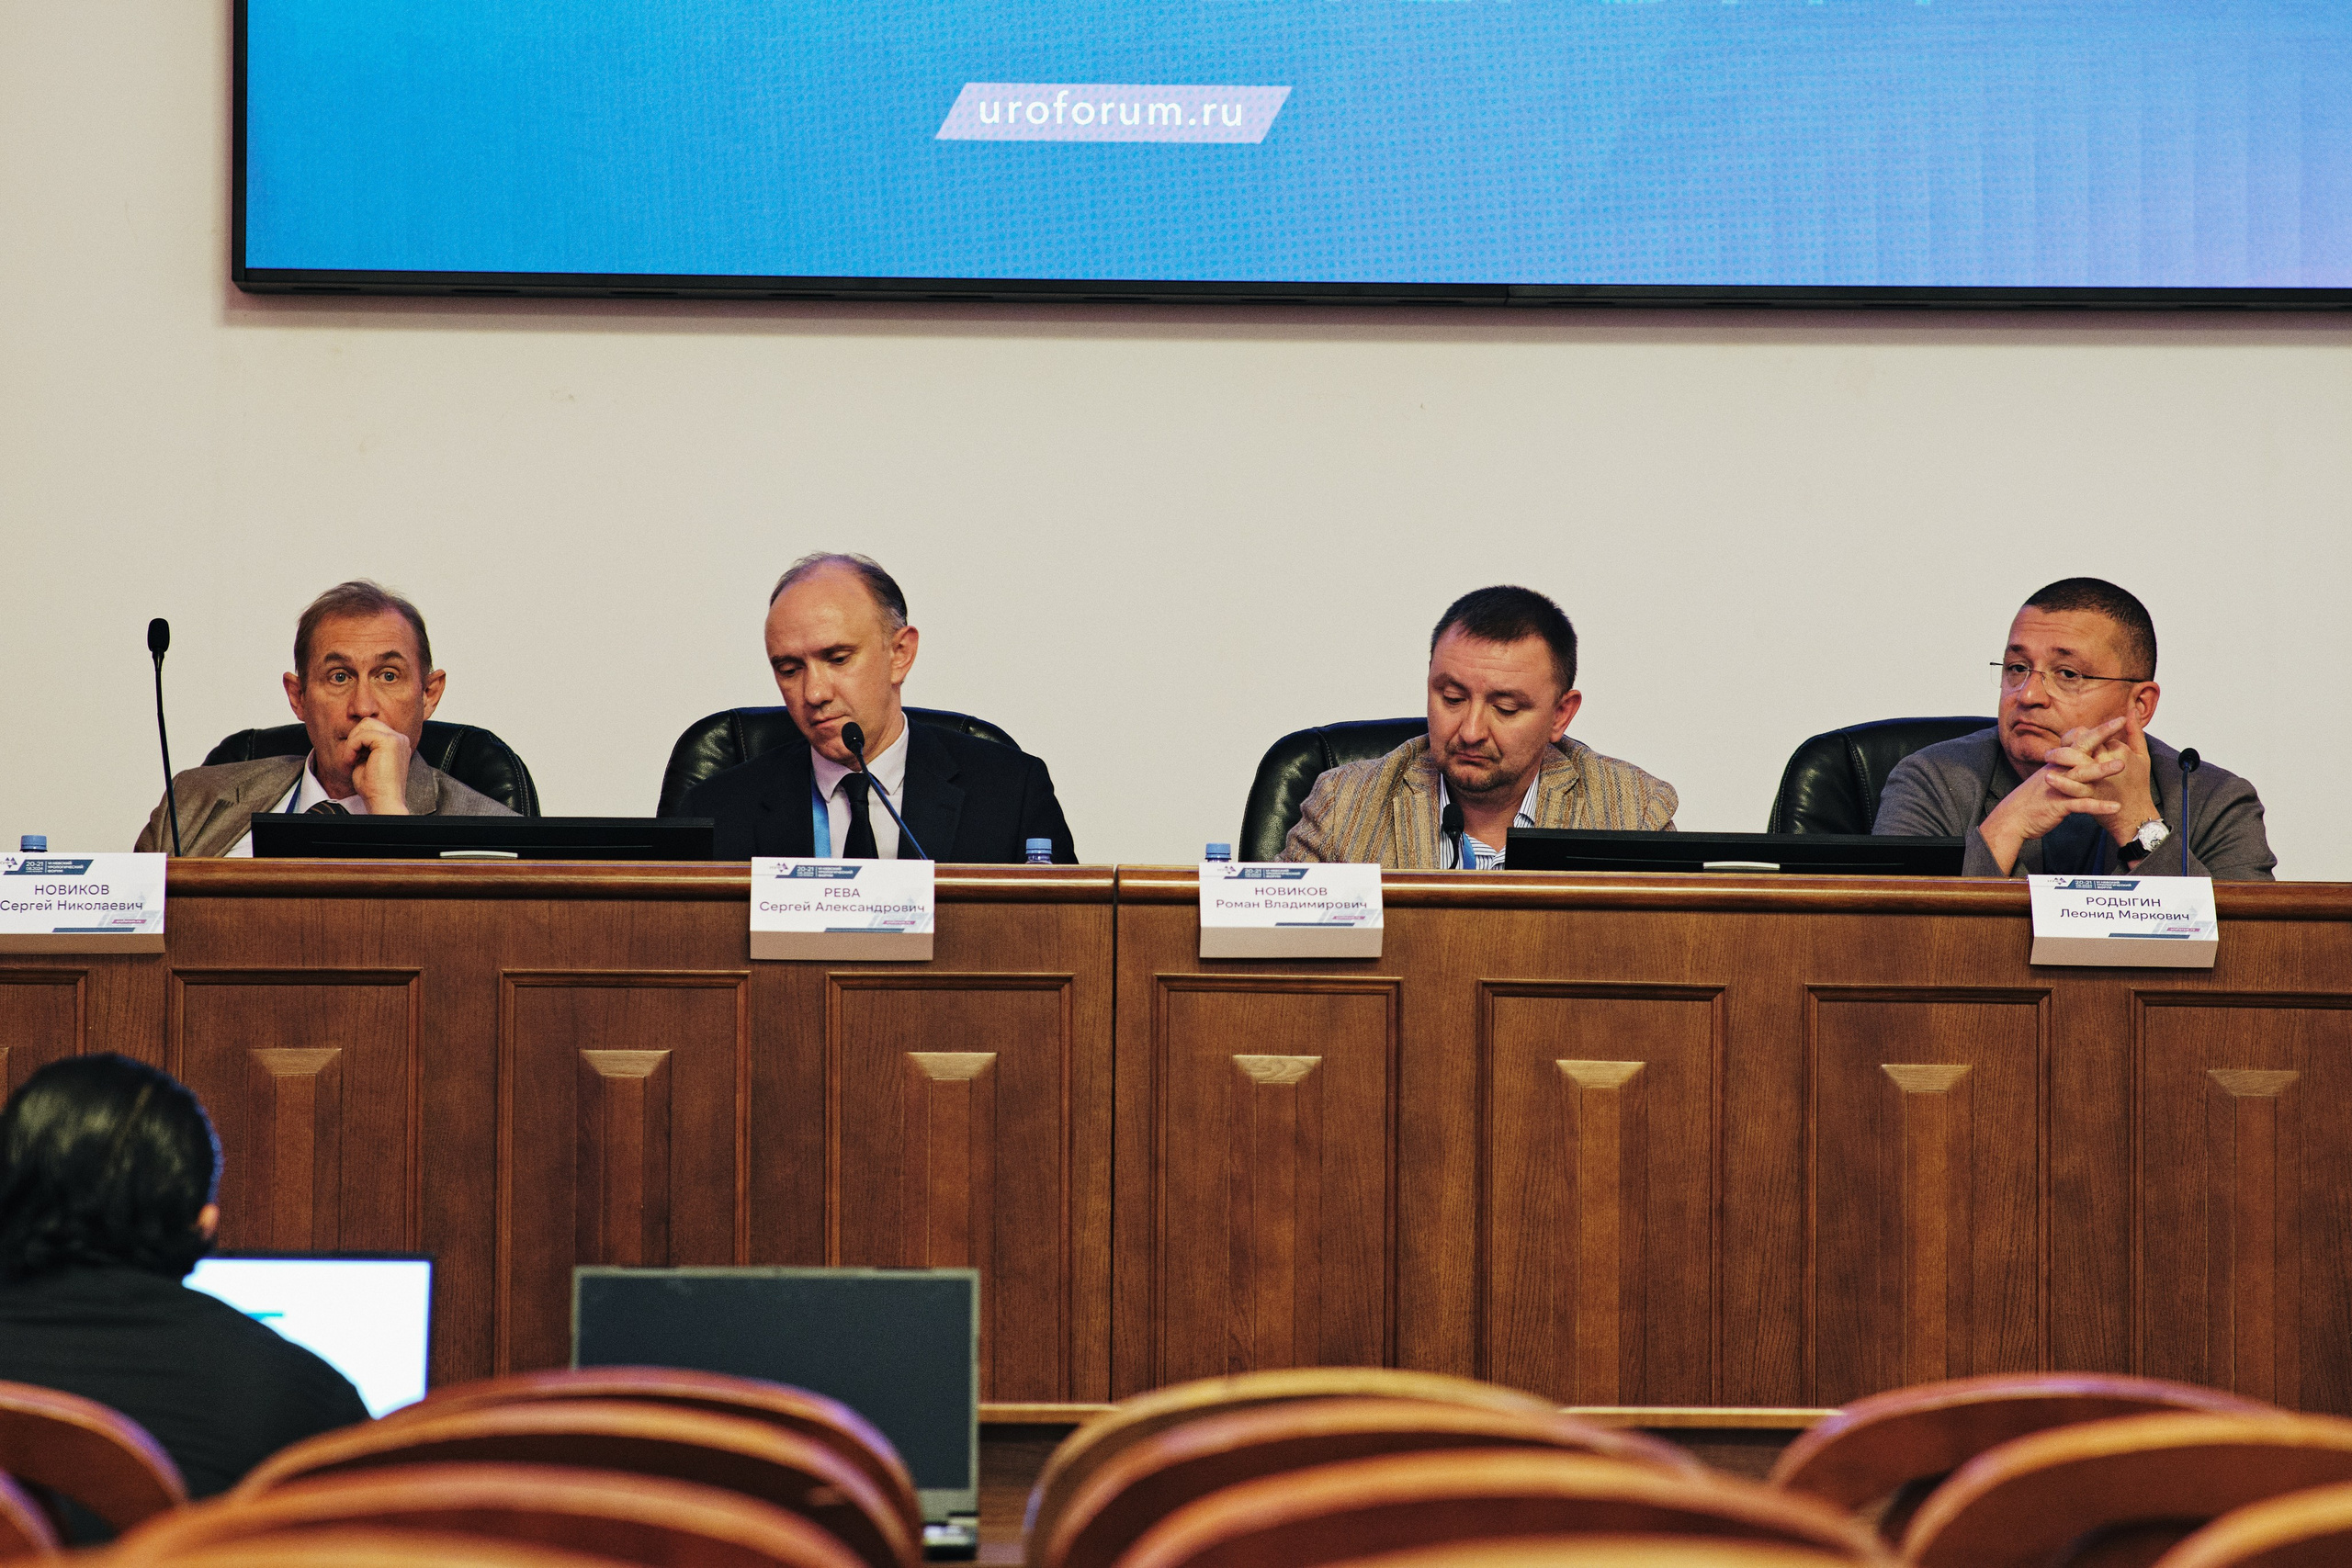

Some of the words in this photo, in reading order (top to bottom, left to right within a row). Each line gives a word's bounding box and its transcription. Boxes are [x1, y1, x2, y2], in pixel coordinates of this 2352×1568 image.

[978, 89, 1243, 127] uroforum.ru
[34, 885, 110, 896] НОВИКОВ
[824, 887, 861, 897] РЕВА
[1254, 886, 1329, 897] НОВИКОВ
[0, 899, 52, 913] Сергей
[57, 899, 143, 911] Николаевич
[759, 901, 810, 913] Сергей
[815, 902, 925, 914] Александрович
[1216, 899, 1260, 908] Роман
[1264, 899, 1367, 910] Владимирович
[2086, 897, 2161, 908] РОДЫГИН
[2060, 908, 2114, 919] Леонид
[2119, 909, 2189, 921] Маркович
